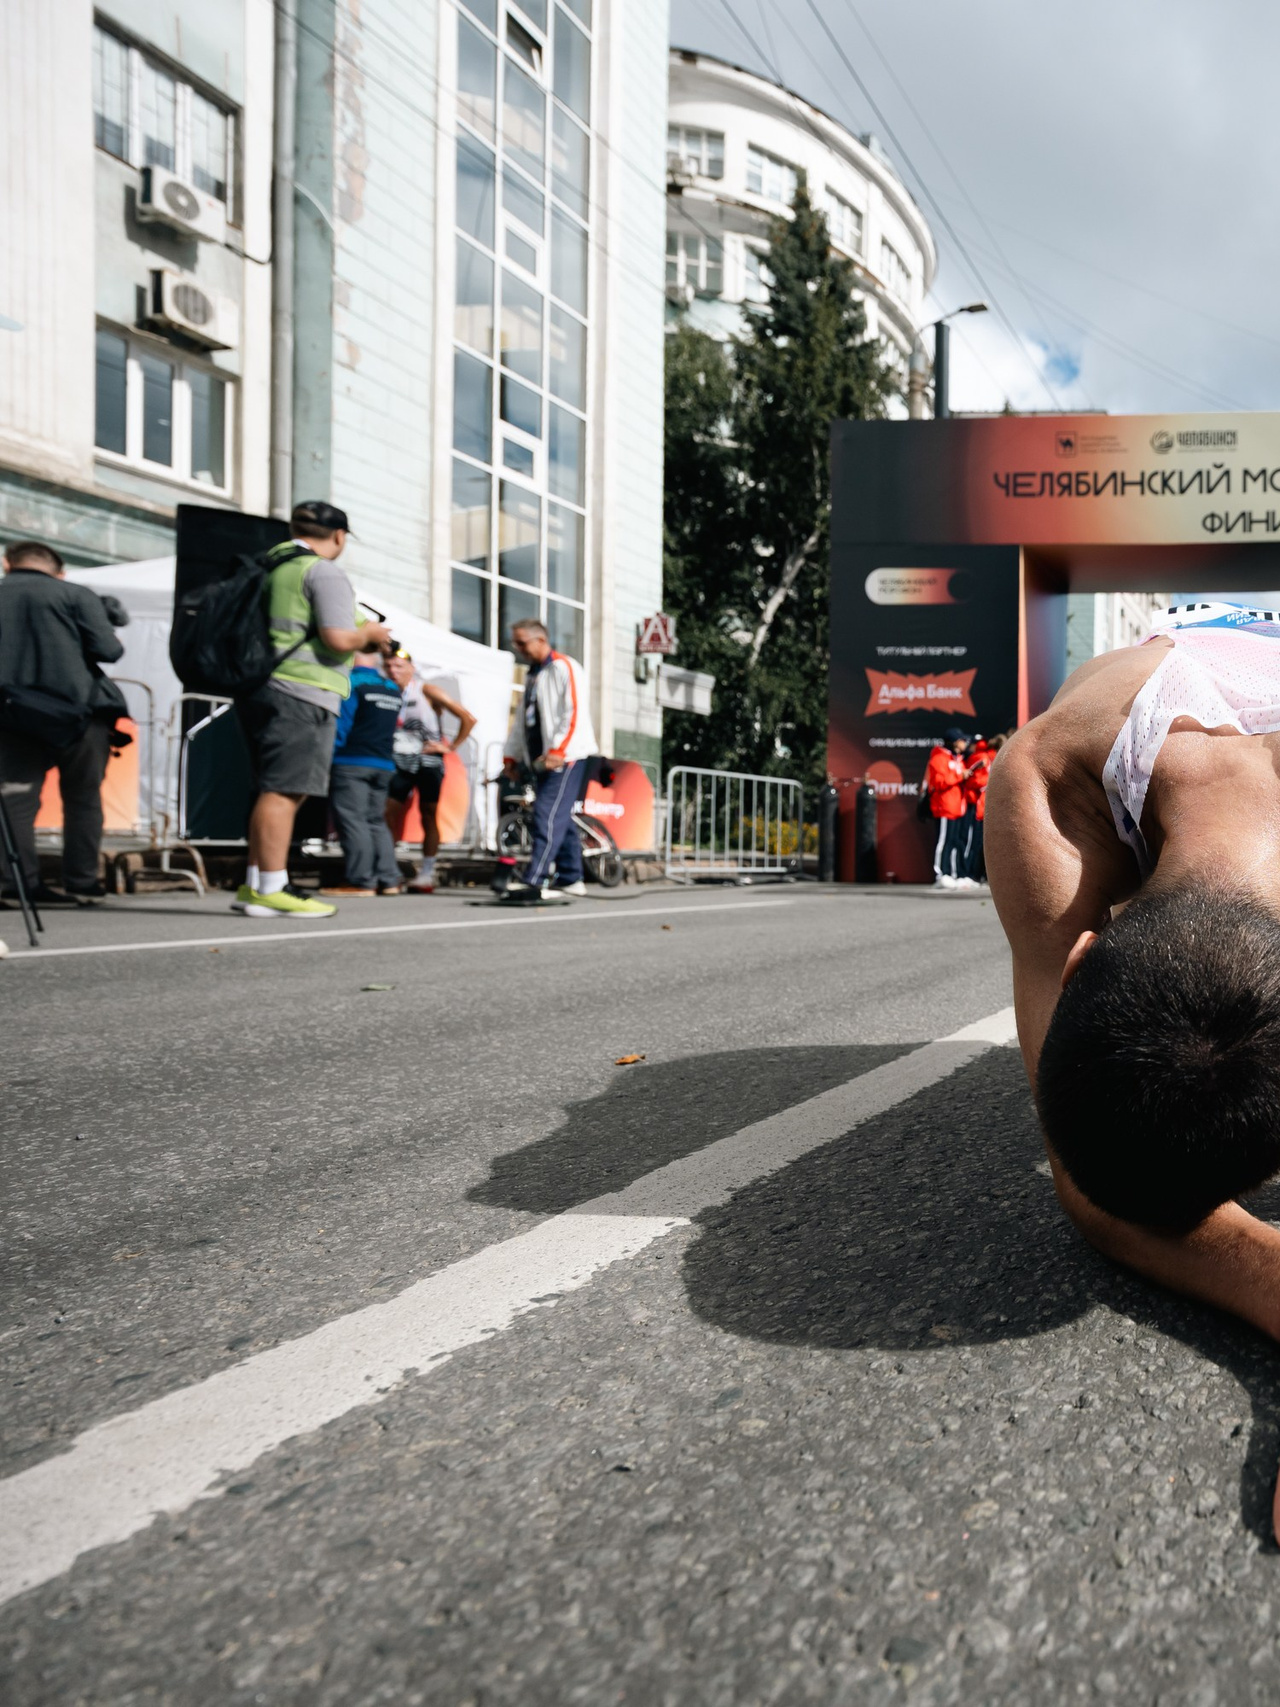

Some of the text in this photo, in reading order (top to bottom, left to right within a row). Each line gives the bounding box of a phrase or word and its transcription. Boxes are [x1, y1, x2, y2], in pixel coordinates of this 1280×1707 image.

[993, 463, 1231, 498] ЧЕЛЯБИНСКИЙ
[878, 683, 962, 701] Альфа Банк
